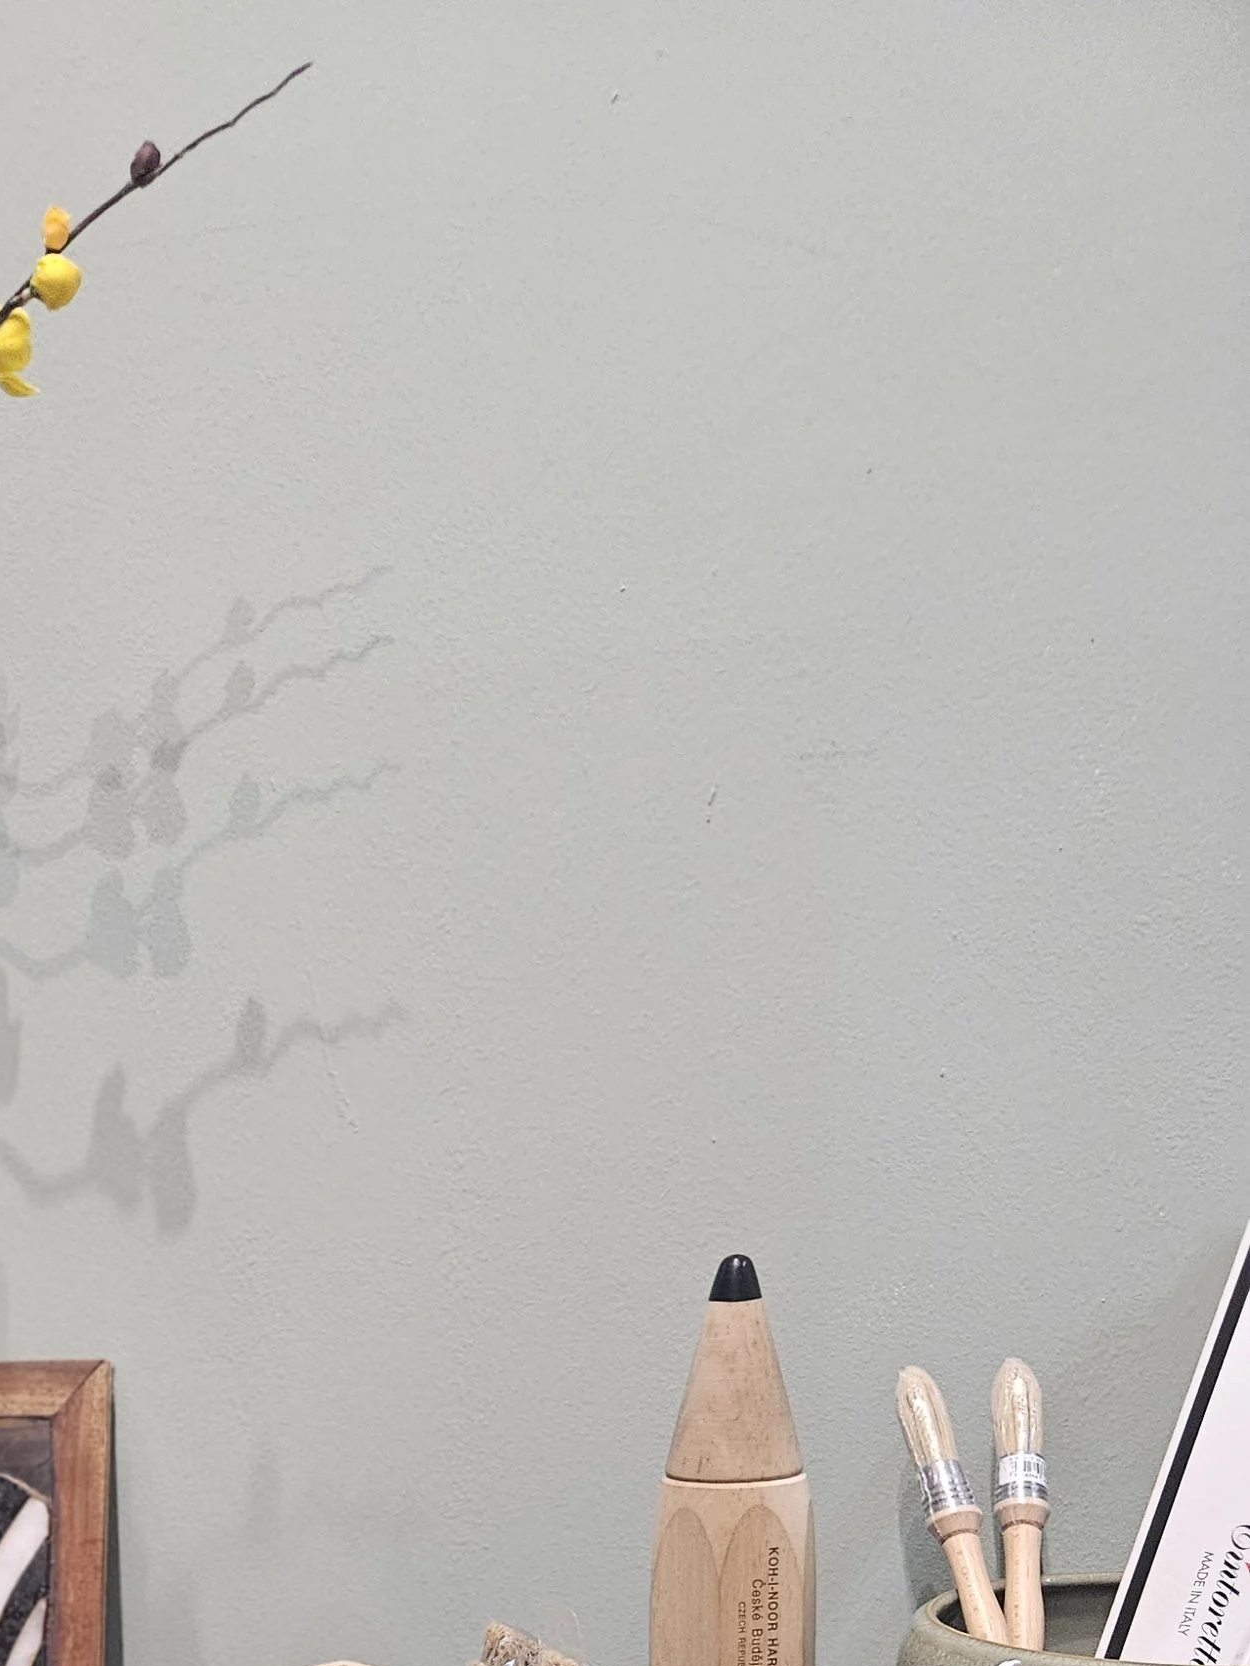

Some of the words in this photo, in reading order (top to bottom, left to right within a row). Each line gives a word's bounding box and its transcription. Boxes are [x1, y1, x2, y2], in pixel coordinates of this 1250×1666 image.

[1193, 1551, 1214, 1587] MADE
[751, 1579, 766, 1621] České
[767, 1546, 779, 1631] KOH-I-NOOR
[1188, 1591, 1202, 1604] IN
[737, 1601, 746, 1634] CZECH
[1178, 1607, 1197, 1637] ITALY
